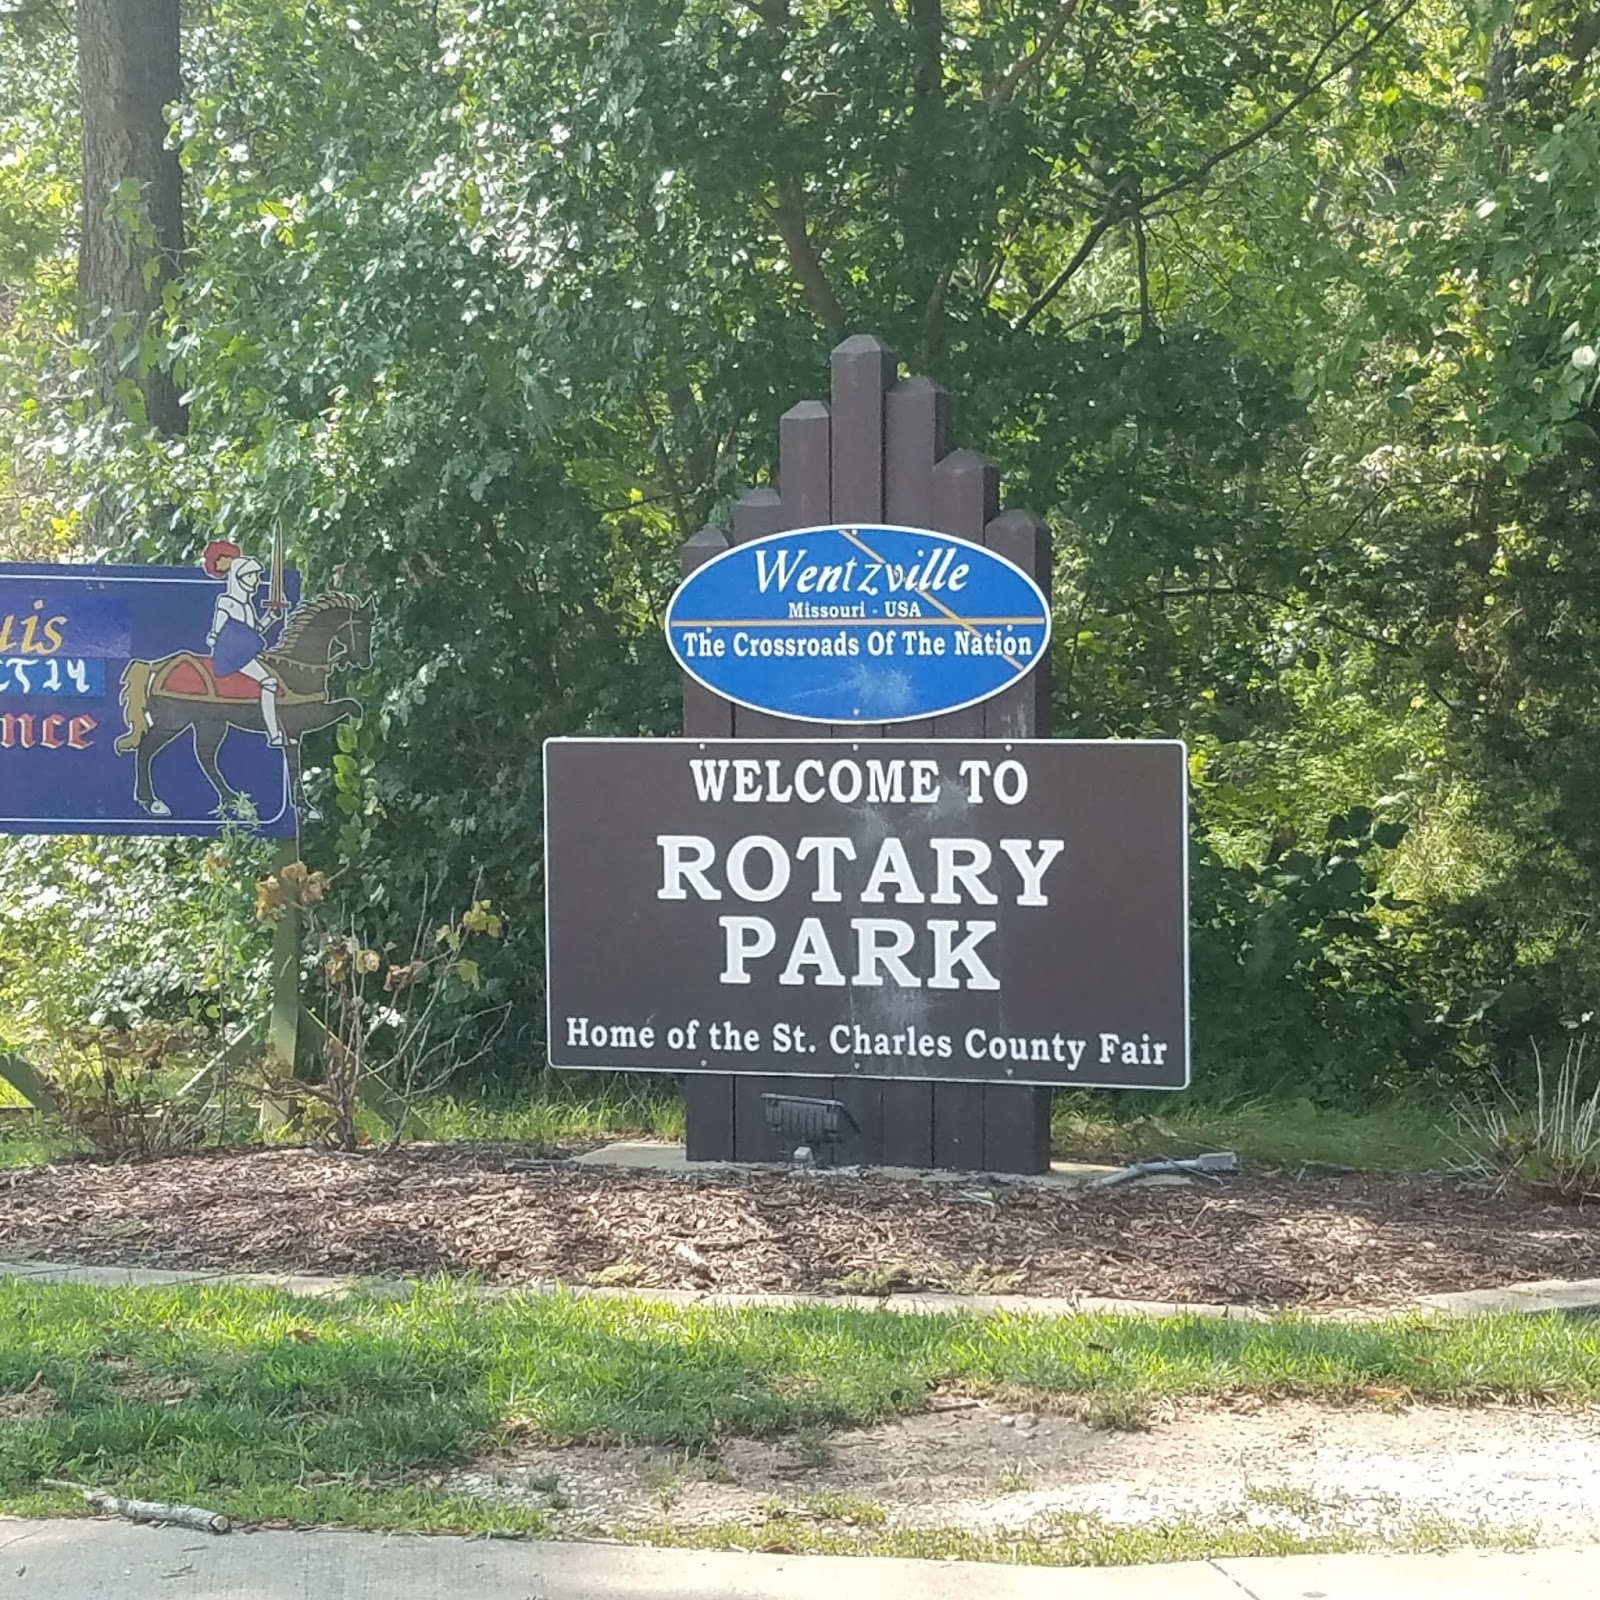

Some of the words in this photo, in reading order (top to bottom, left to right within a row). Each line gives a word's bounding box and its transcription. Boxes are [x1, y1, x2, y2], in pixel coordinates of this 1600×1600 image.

[755, 547, 970, 594] Wentzville
[788, 601, 866, 618] Missouri
[885, 601, 922, 618] USA
[683, 631, 725, 657] The
[733, 631, 859, 657] Crossroads
[867, 631, 896, 656] Of
[904, 631, 945, 656] The
[954, 630, 1033, 656] Nation
[689, 759, 941, 805] WELCOME
[959, 760, 1028, 805] TO
[656, 834, 1065, 906] ROTARY
[719, 915, 1000, 991] PARK
[566, 1016, 655, 1049] Home
[667, 1019, 700, 1050] of
[708, 1020, 760, 1052] the
[773, 1022, 816, 1054] St.
[829, 1024, 953, 1058] Charles
[965, 1028, 1086, 1072] County
[1099, 1033, 1167, 1066] Fair
